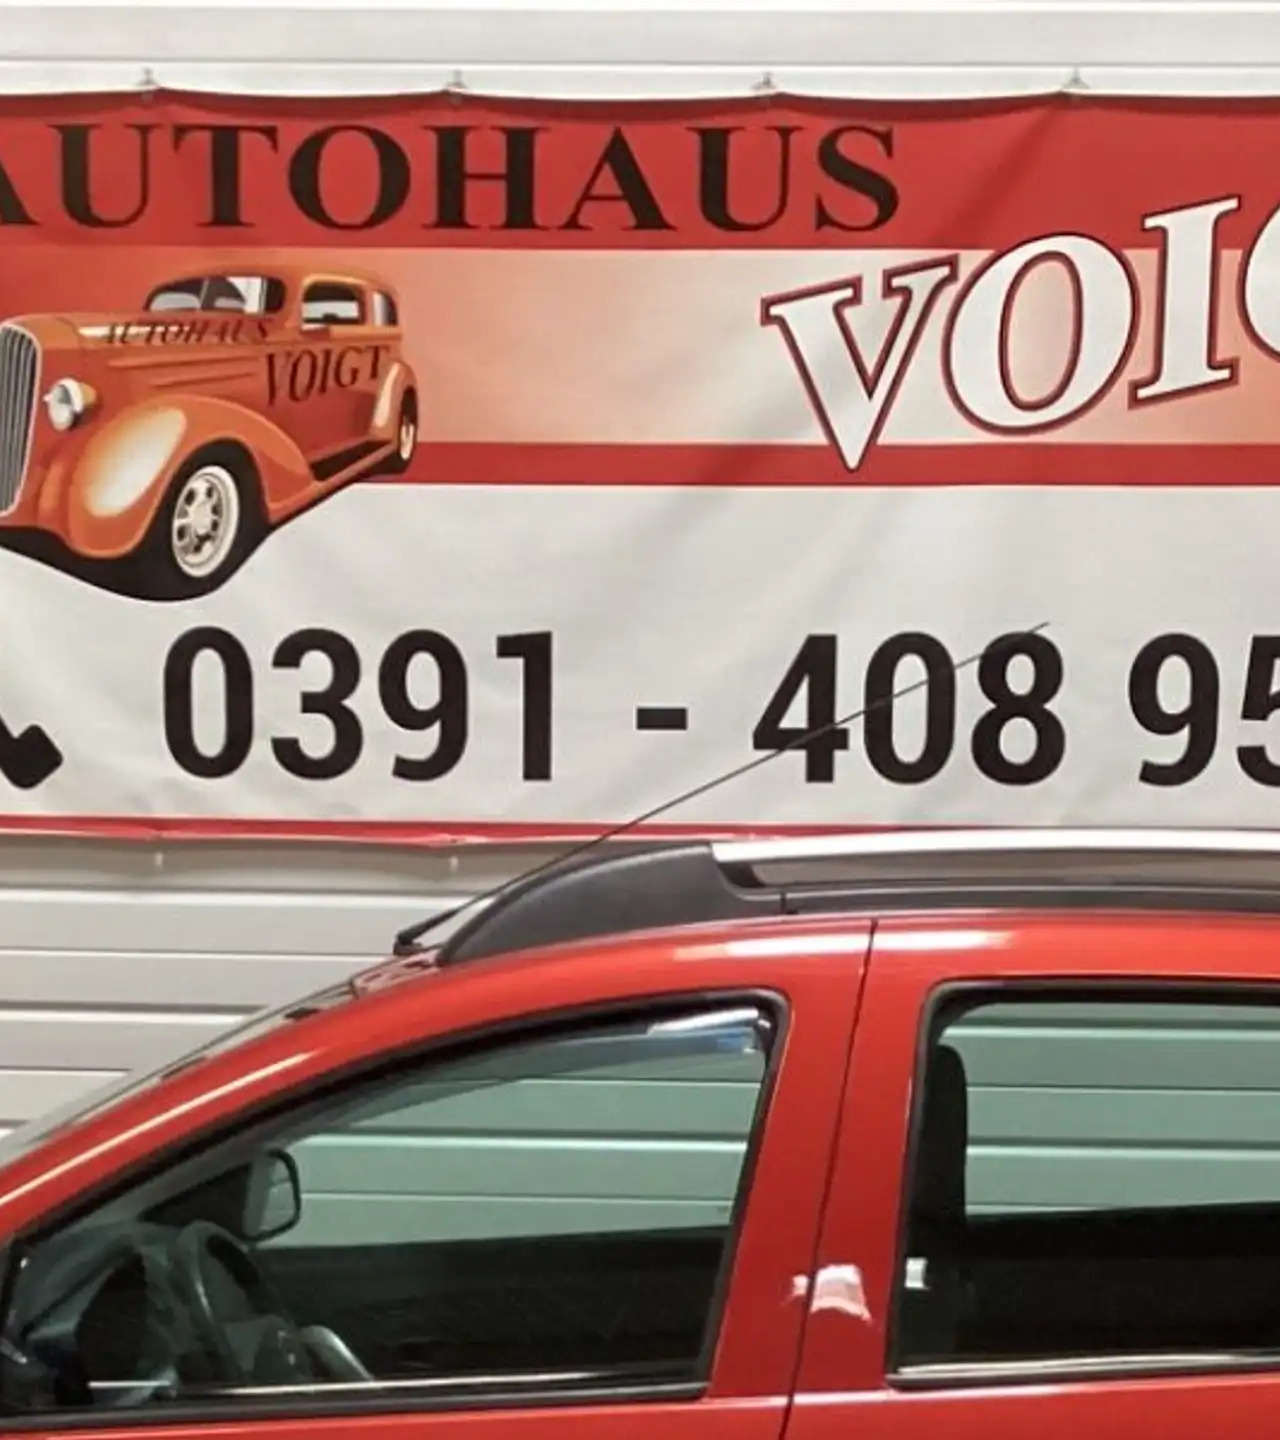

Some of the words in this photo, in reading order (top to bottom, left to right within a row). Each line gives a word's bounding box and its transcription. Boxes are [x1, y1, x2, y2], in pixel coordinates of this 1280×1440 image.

[101, 318, 273, 346] AUTOHAUS
[263, 345, 391, 407] VOIGT
[162, 626, 554, 784] 0391
[752, 630, 1066, 787] 408
